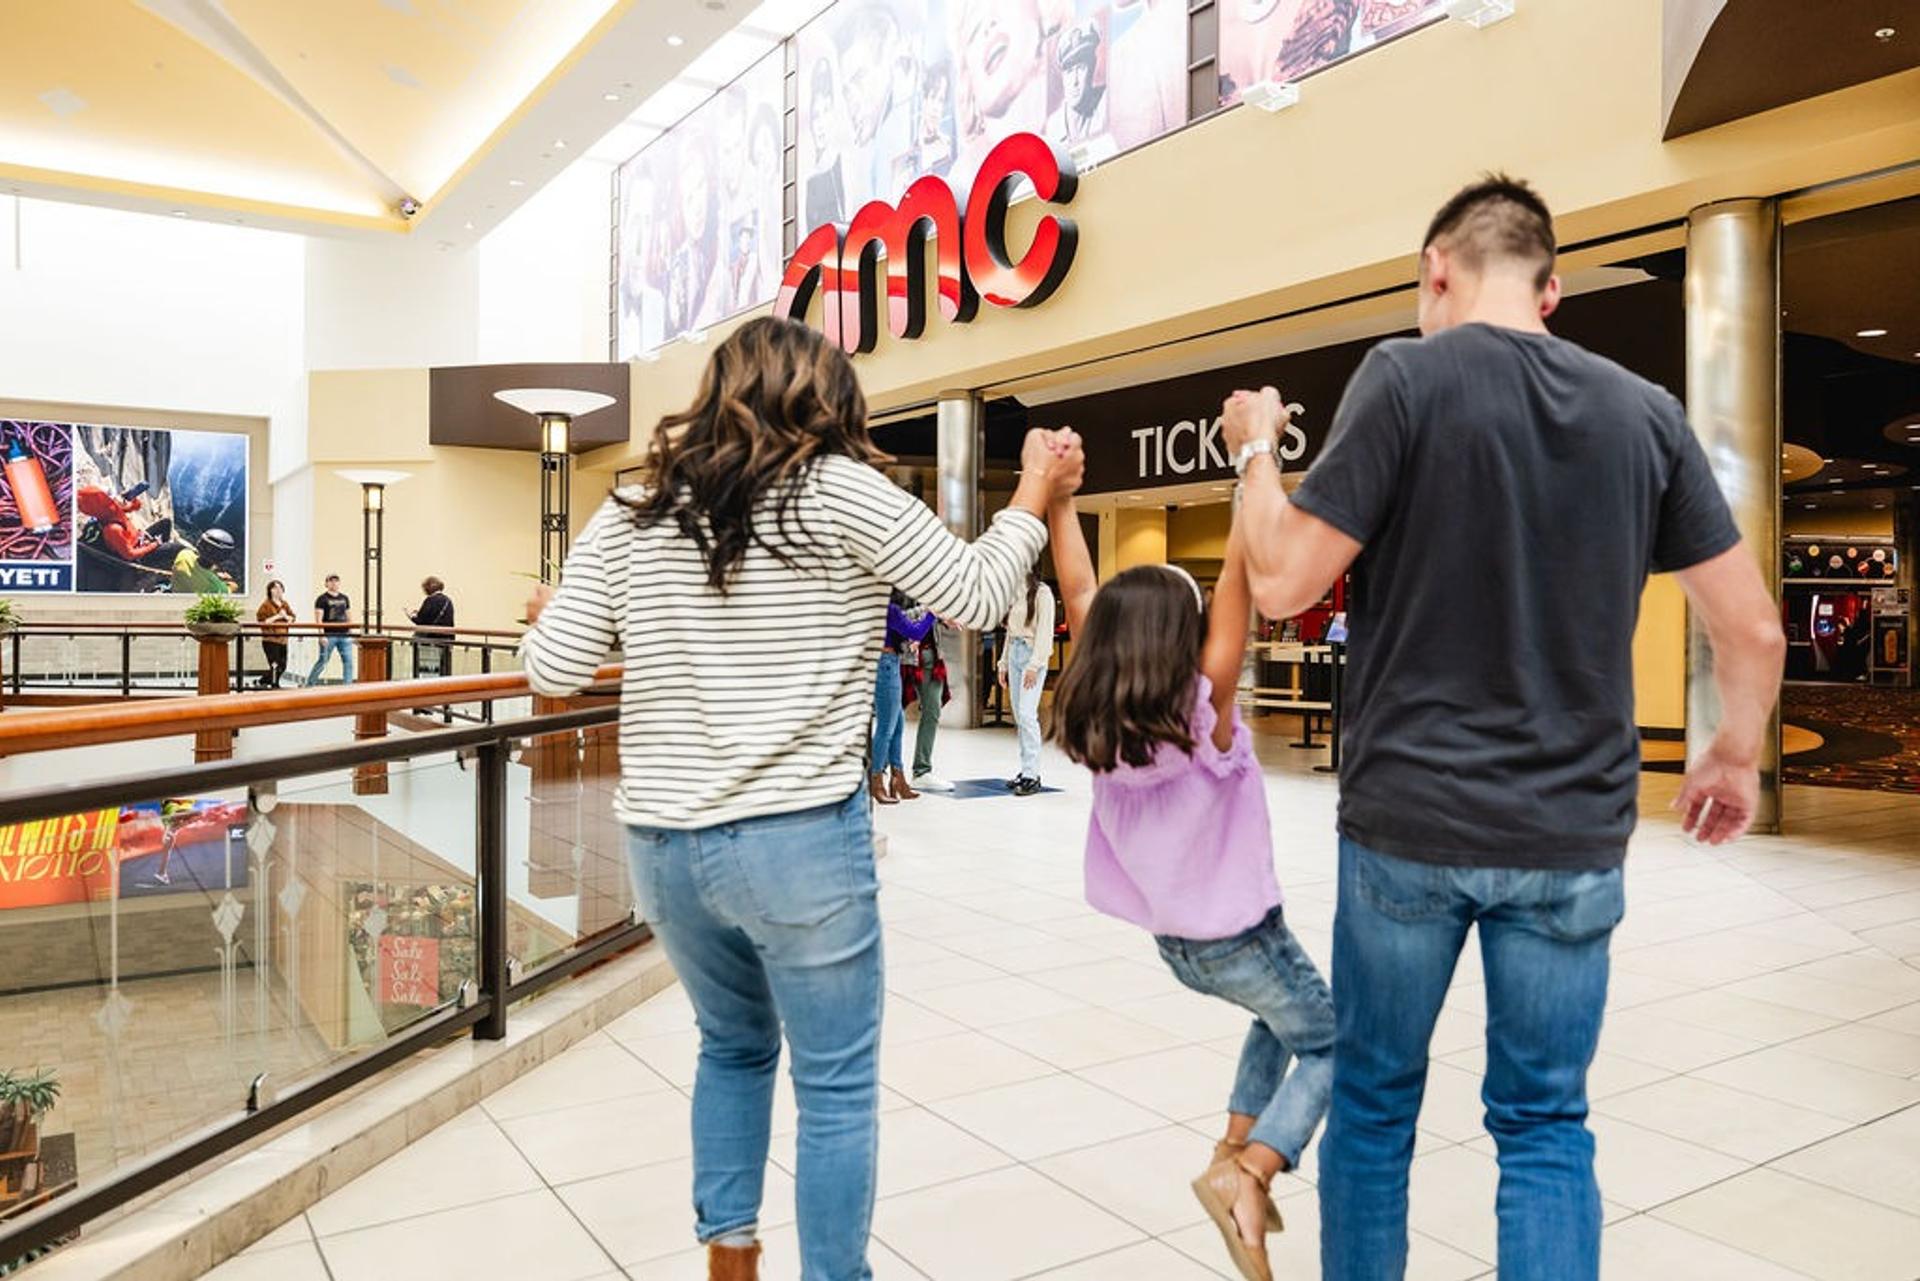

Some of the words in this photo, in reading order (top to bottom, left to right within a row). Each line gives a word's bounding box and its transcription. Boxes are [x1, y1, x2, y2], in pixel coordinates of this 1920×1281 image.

[773, 131, 1078, 356] amc
[1131, 402, 1307, 478] TICKS
[0, 568, 60, 586] YETI
